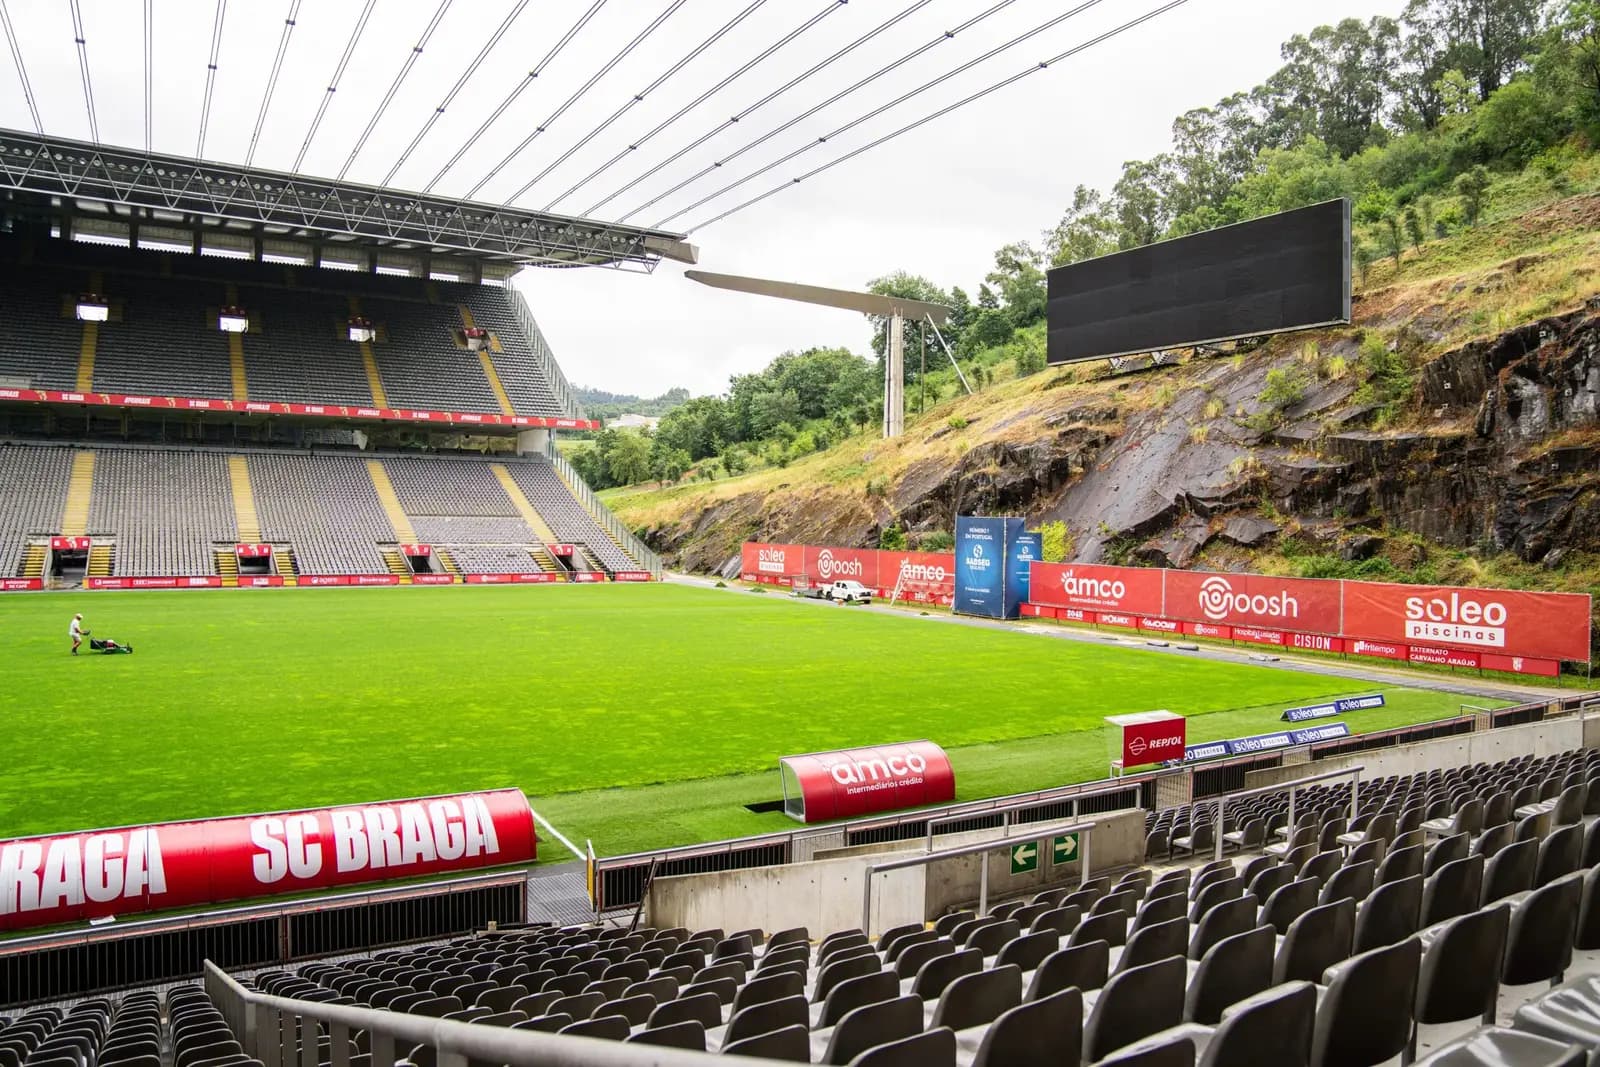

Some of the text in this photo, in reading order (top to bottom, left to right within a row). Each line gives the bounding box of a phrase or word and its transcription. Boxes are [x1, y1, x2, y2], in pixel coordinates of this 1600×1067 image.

[759, 547, 785, 562] soleo
[1064, 577, 1125, 599] amco
[1405, 592, 1507, 626] soleo
[1413, 623, 1496, 642] piscinas
[1295, 634, 1331, 650] CISION
[1410, 646, 1448, 656] EXTERNATO
[1410, 654, 1476, 667] CARVALHO ARAÚJO
[1340, 699, 1360, 710] soleo
[1291, 708, 1312, 720] soleo
[1149, 736, 1182, 749] REPSOL
[1296, 729, 1320, 743] soleo
[1234, 739, 1260, 752] soleo
[830, 752, 927, 785] amco
[847, 777, 923, 795] intermediários crédito
[249, 794, 499, 883] SC BRAGA
